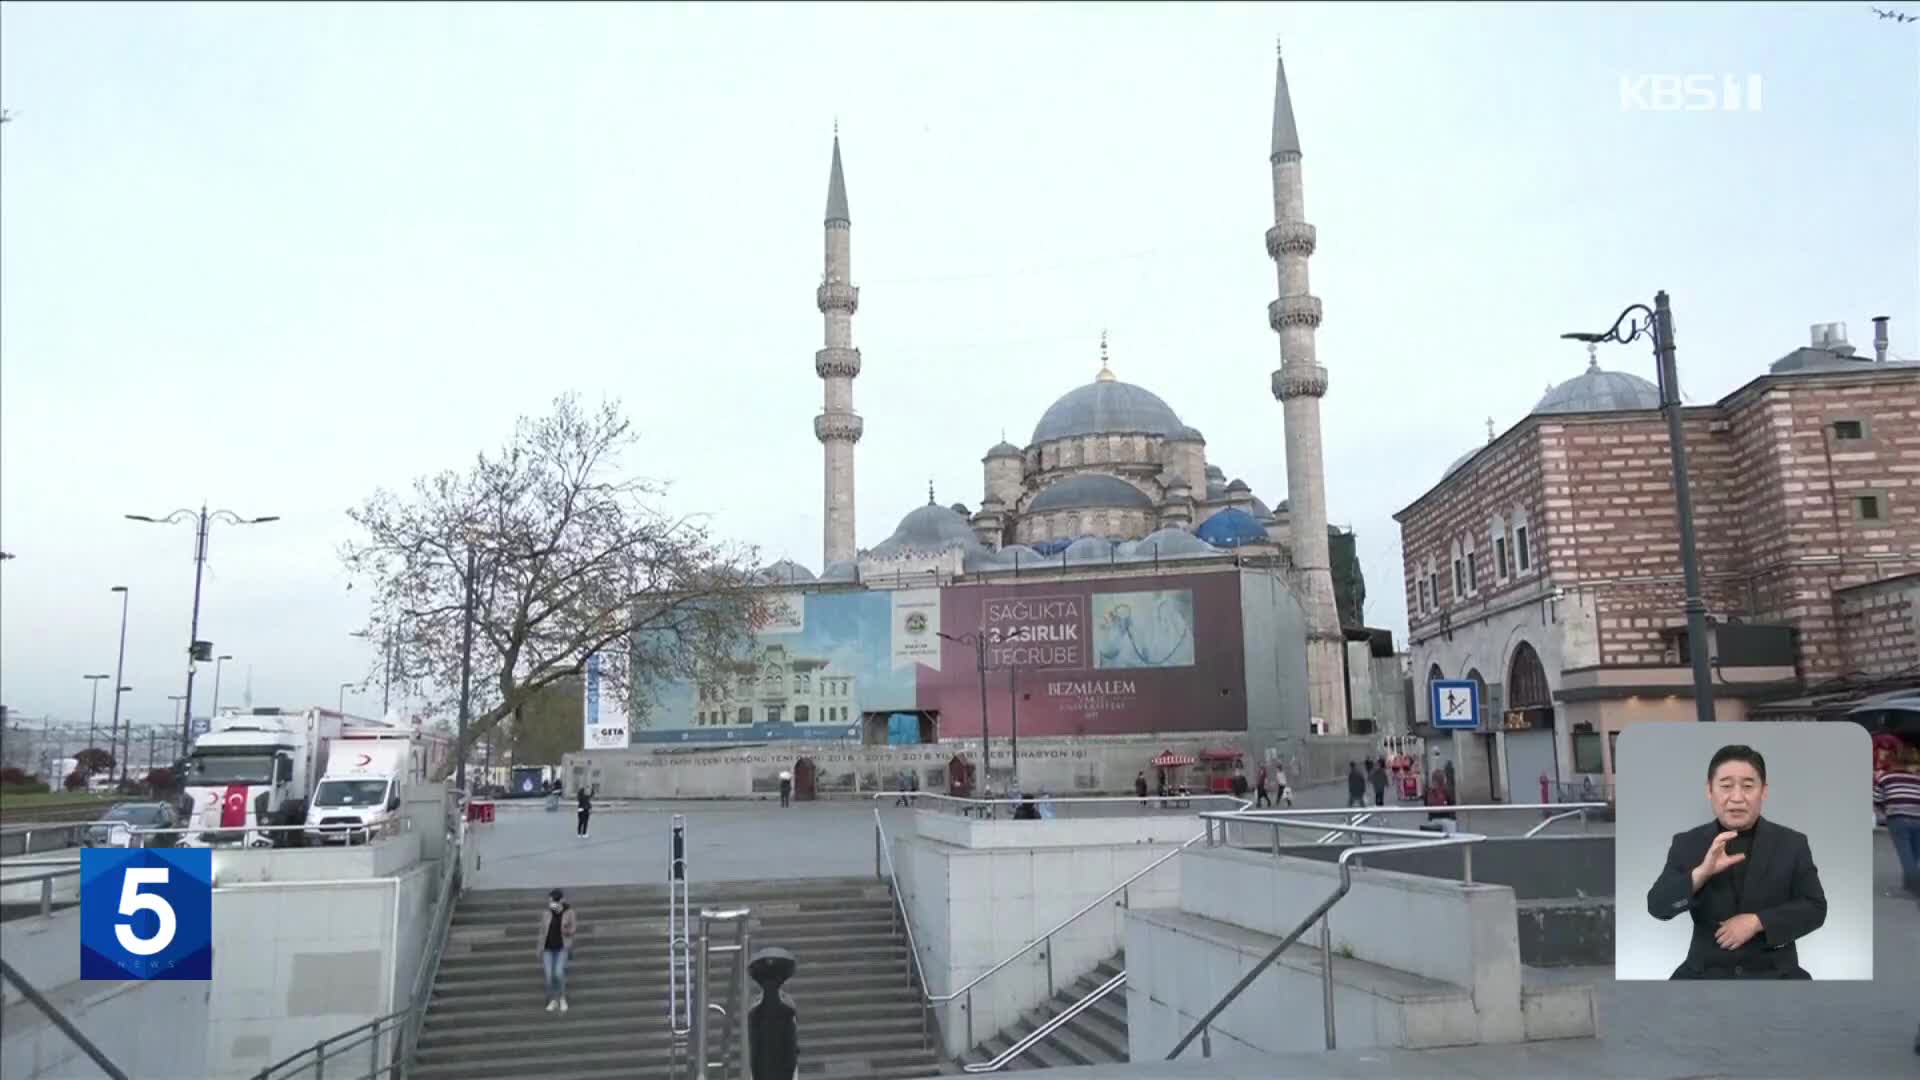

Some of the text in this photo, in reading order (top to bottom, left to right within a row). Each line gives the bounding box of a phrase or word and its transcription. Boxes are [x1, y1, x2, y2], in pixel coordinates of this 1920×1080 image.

[989, 600, 1079, 622] SAĞLIKTA
[1005, 624, 1079, 643] ASIRLIK
[600, 727, 625, 737] GETA
